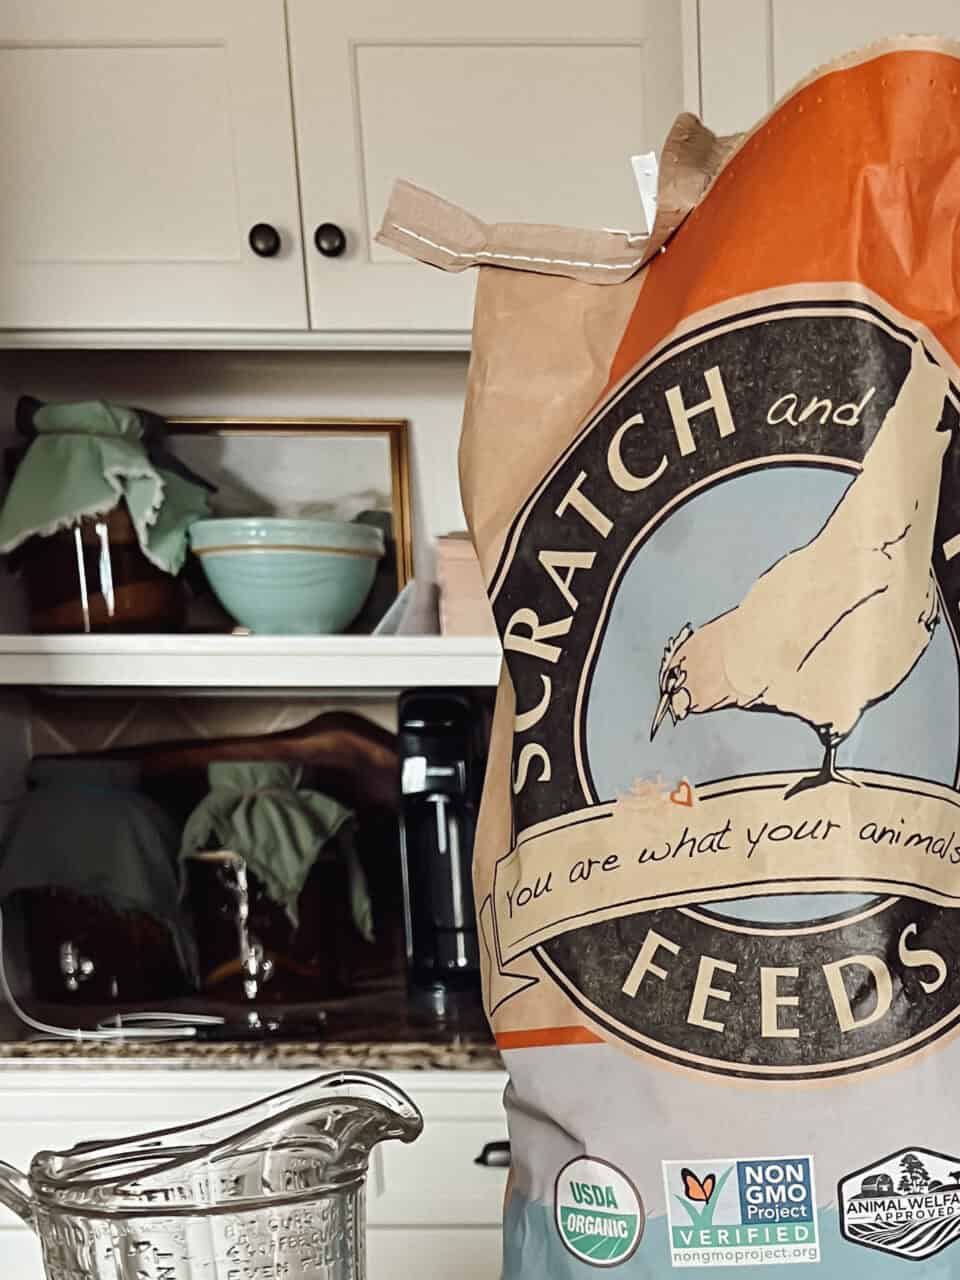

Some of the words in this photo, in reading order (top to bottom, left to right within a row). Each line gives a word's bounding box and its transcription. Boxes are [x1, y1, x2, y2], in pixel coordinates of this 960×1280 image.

[503, 366, 736, 795] SCRATCH
[767, 388, 876, 428] and
[569, 853, 620, 883] are
[638, 819, 732, 864] what
[747, 818, 841, 858] your
[621, 922, 948, 1039] FEEDS
[744, 1164, 804, 1184] NON
[569, 1181, 618, 1210] USDA
[745, 1183, 807, 1205] GMO
[747, 1204, 808, 1222] Project
[847, 1199, 907, 1214] ANIMAL
[874, 1206, 955, 1222] APPROVED
[567, 1213, 629, 1239] ORGANIC
[680, 1225, 809, 1246] VERIFIED
[673, 1246, 818, 1265] nongmoproject.org
